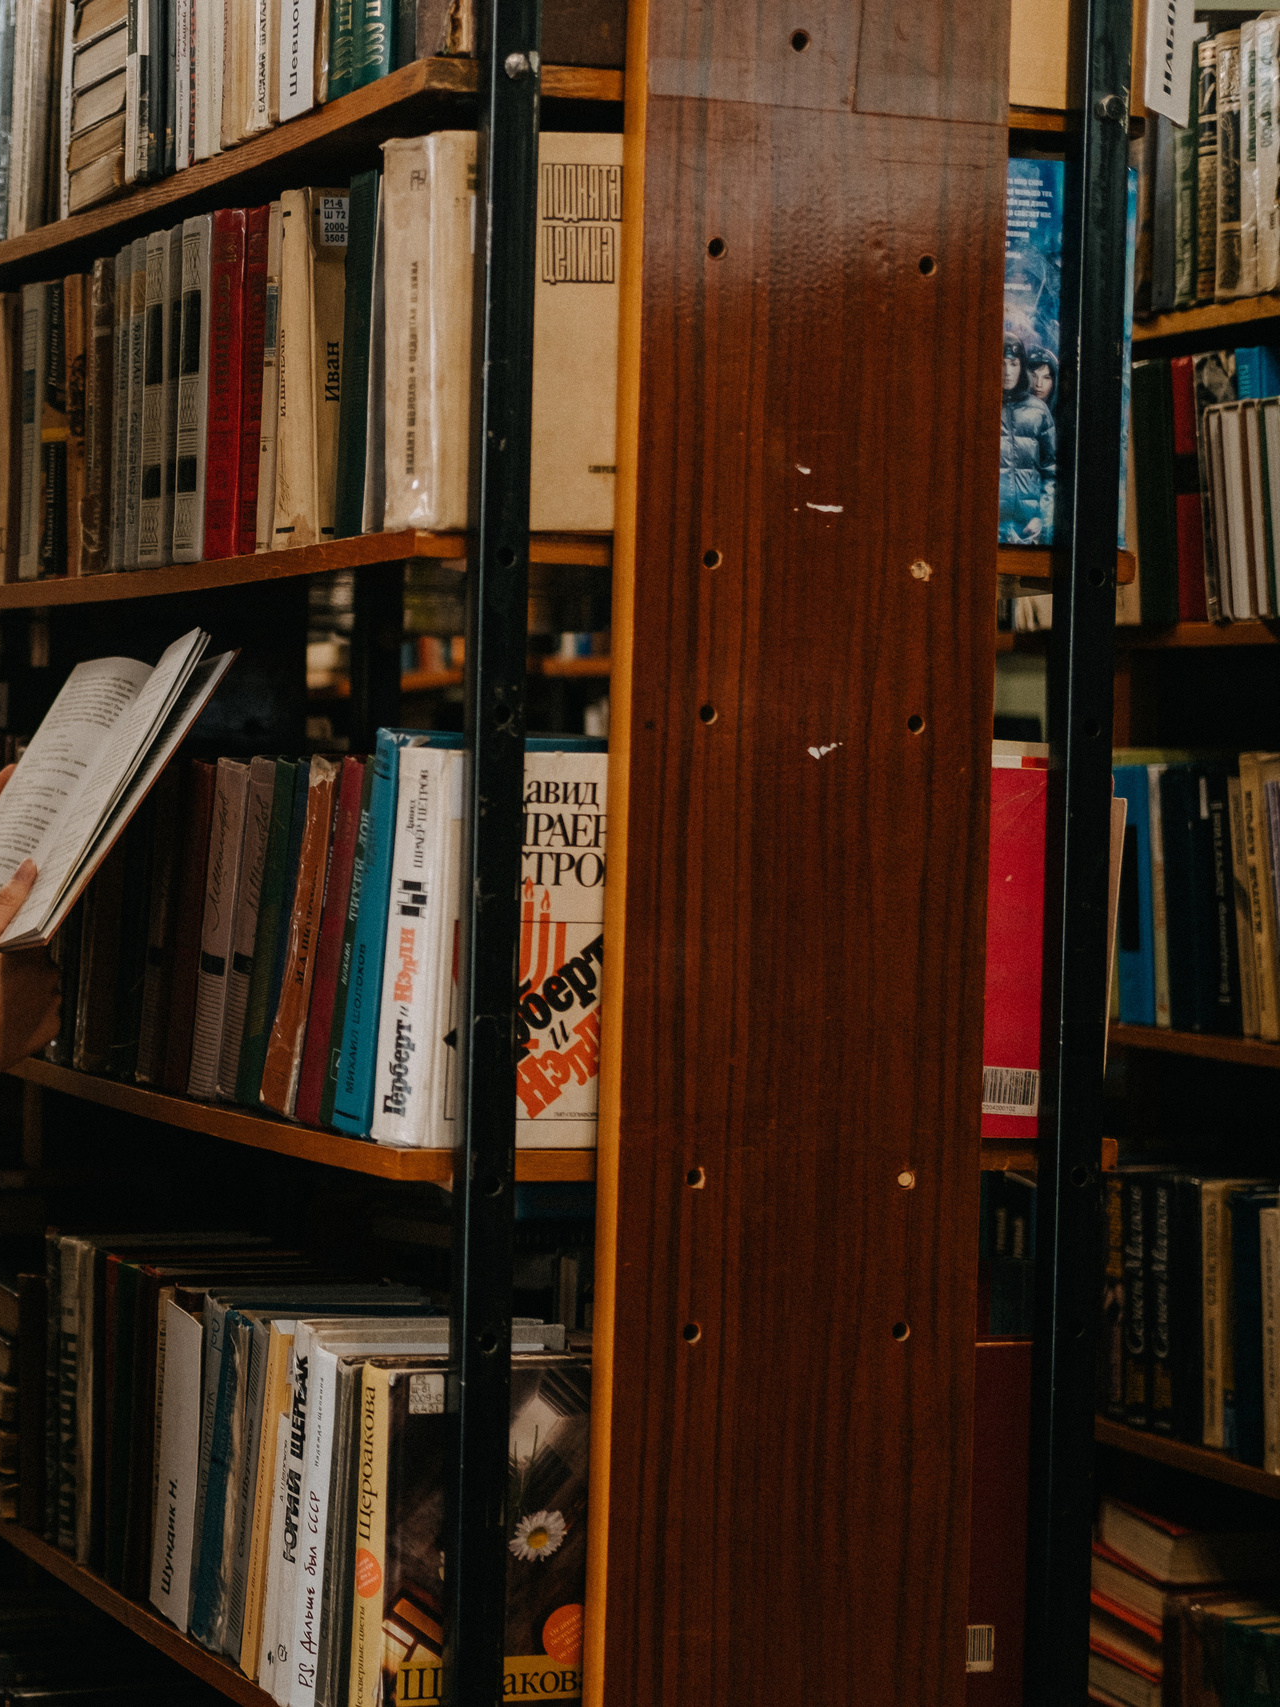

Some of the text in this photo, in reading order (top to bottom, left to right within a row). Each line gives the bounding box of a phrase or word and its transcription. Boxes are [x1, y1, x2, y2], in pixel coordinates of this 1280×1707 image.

[324, 234, 345, 243] 3505
[335, 211, 346, 219] 72
[325, 341, 341, 403] Иван
[521, 779, 601, 813] авид
[520, 850, 607, 889] ТРО
[345, 943, 367, 1095] МИХАИЛ ШОЛОХОВ
[383, 1018, 414, 1117] Герберт
[283, 1350, 309, 1564] ЮРИЙ ЩЕРБАК
[160, 1478, 177, 1596] Шундик Н.
[298, 1490, 321, 1689] P.S. Дальше был СССР
[355, 1642, 366, 1707] ескверные
